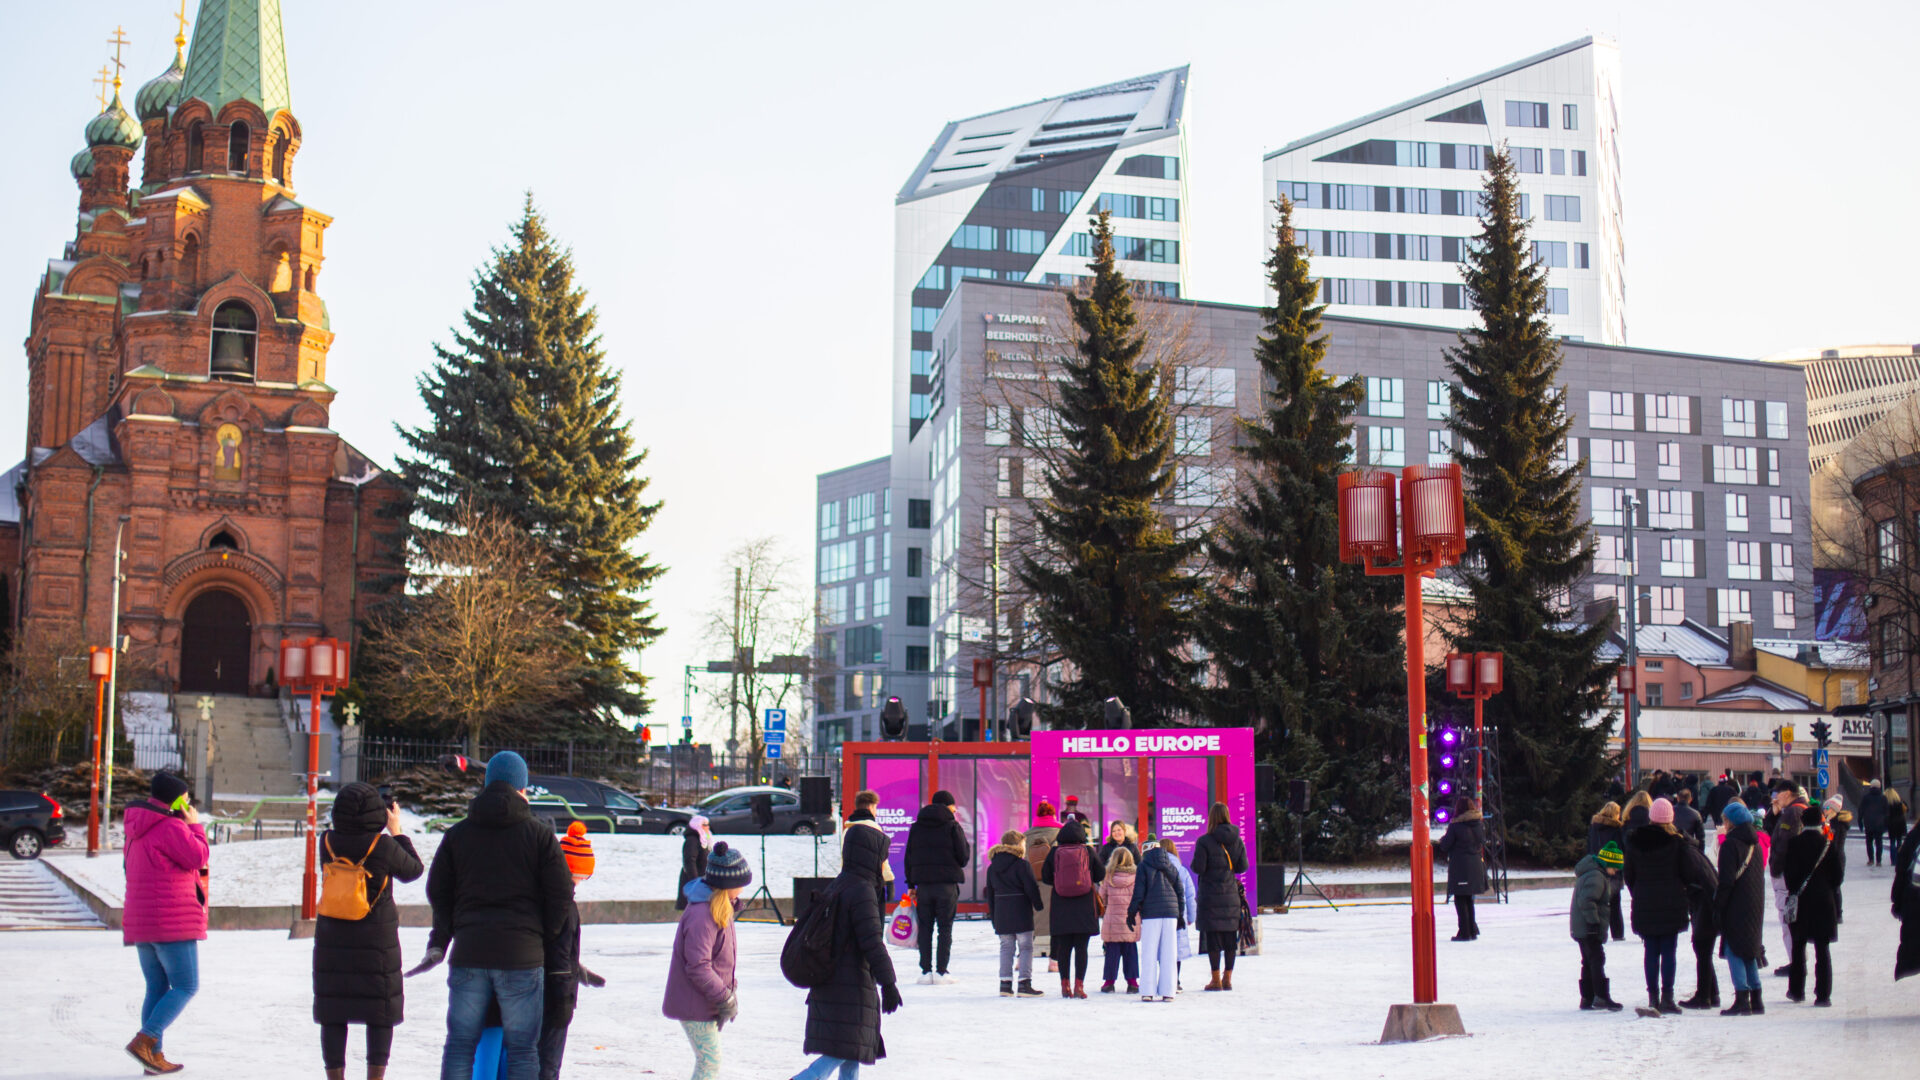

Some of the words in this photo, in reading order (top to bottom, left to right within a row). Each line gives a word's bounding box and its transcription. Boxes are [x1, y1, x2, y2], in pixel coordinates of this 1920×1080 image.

[998, 313, 1046, 325] TAPPARA
[769, 711, 783, 729] P
[1062, 736, 1130, 753] HELLO
[1135, 735, 1221, 752] EUROPE
[1162, 807, 1194, 816] HELLO
[1162, 815, 1206, 824] EUROPE,
